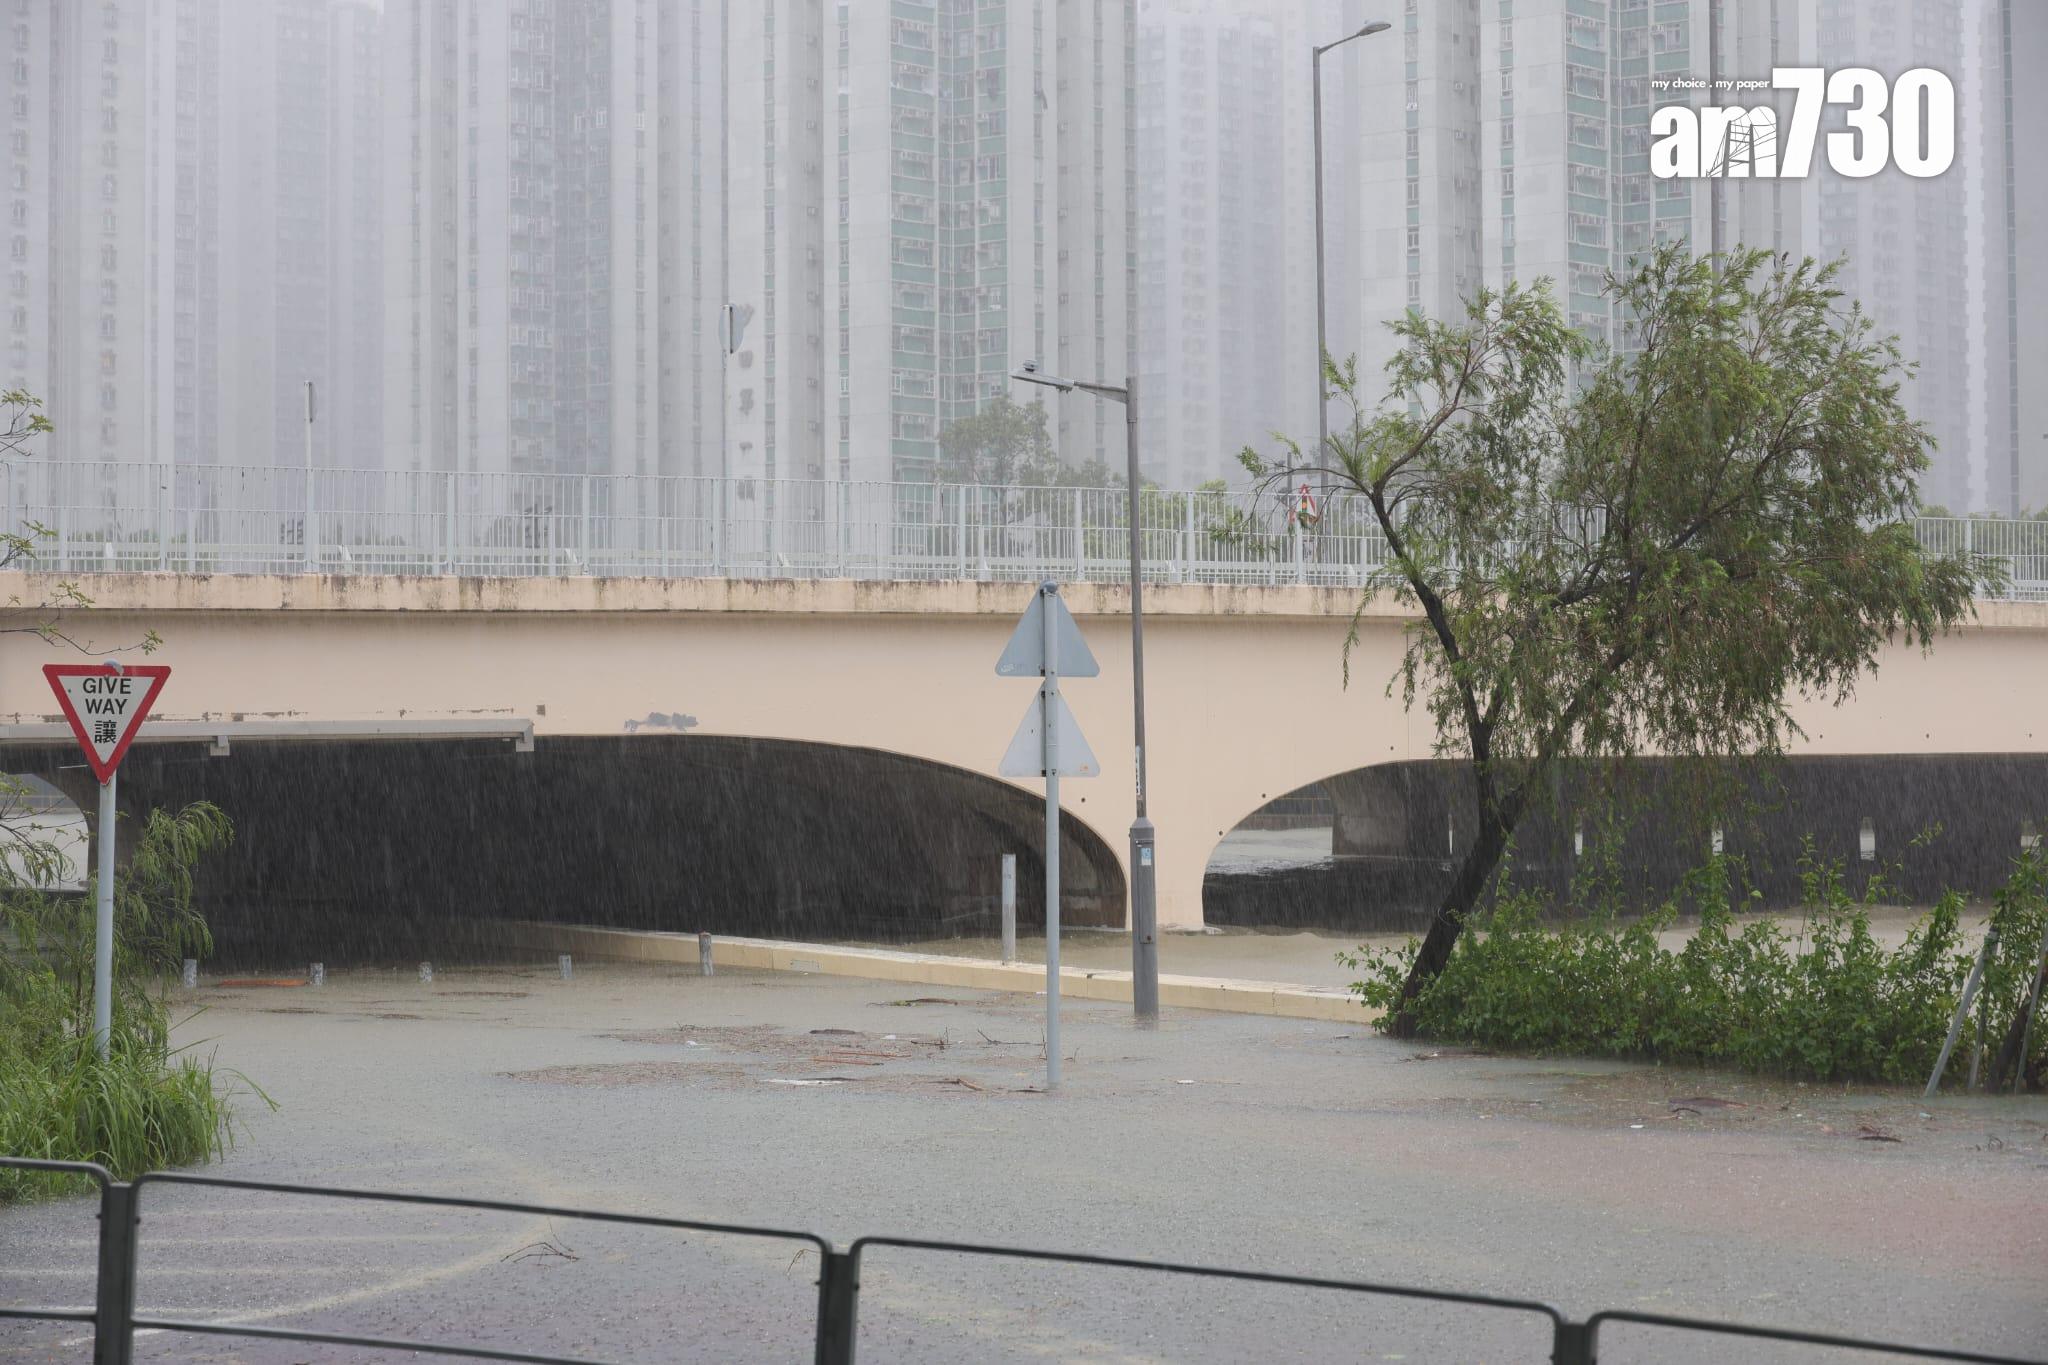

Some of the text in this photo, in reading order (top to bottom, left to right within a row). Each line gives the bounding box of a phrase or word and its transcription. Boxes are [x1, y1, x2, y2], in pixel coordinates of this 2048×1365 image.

[82, 677, 132, 695] GIVE
[85, 698, 128, 715] WAY
[94, 720, 117, 744] 讓
